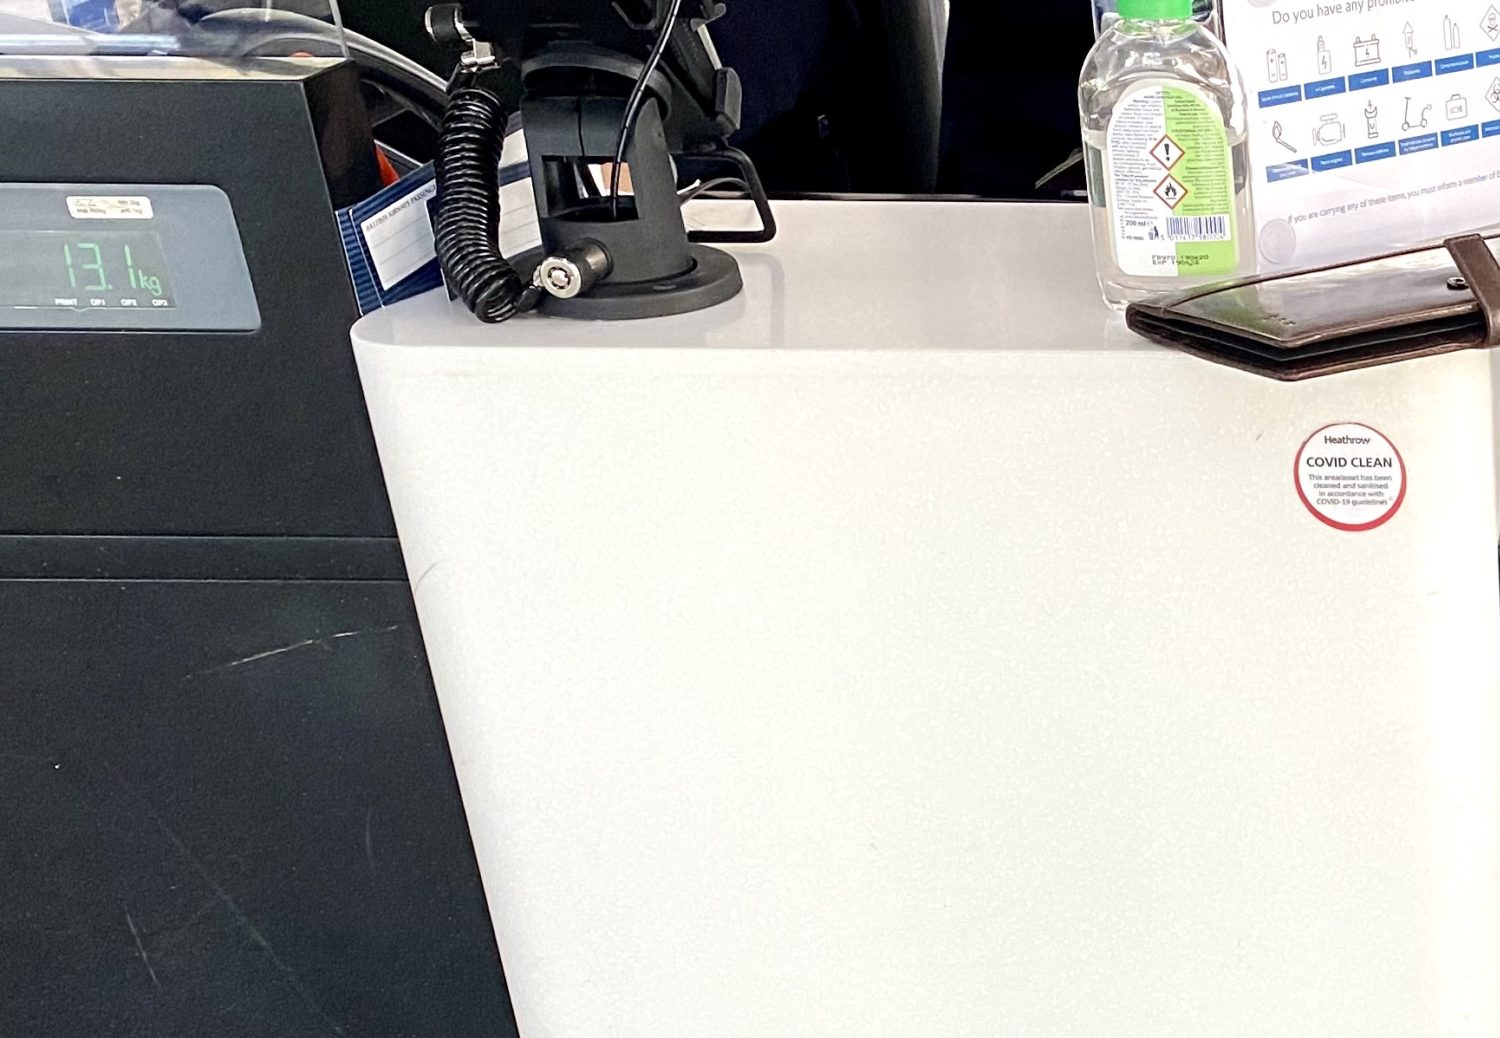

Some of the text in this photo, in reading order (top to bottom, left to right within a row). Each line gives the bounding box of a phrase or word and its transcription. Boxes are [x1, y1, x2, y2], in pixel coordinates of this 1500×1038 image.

[1271, 10, 1290, 25] Do
[1292, 8, 1314, 24] you
[1316, 3, 1343, 17] have
[1345, 0, 1364, 13] any
[1294, 215, 1307, 224] you
[1319, 205, 1346, 217] carrying
[1360, 200, 1367, 208] of
[1368, 196, 1387, 206] these
[1407, 190, 1420, 200] you
[1420, 186, 1436, 194] must
[1489, 170, 1496, 180] of
[1323, 435, 1371, 445] Heathrow
[1306, 456, 1393, 468] COVID CLEAN
[1316, 498, 1388, 507] COVID-19 guidelines
